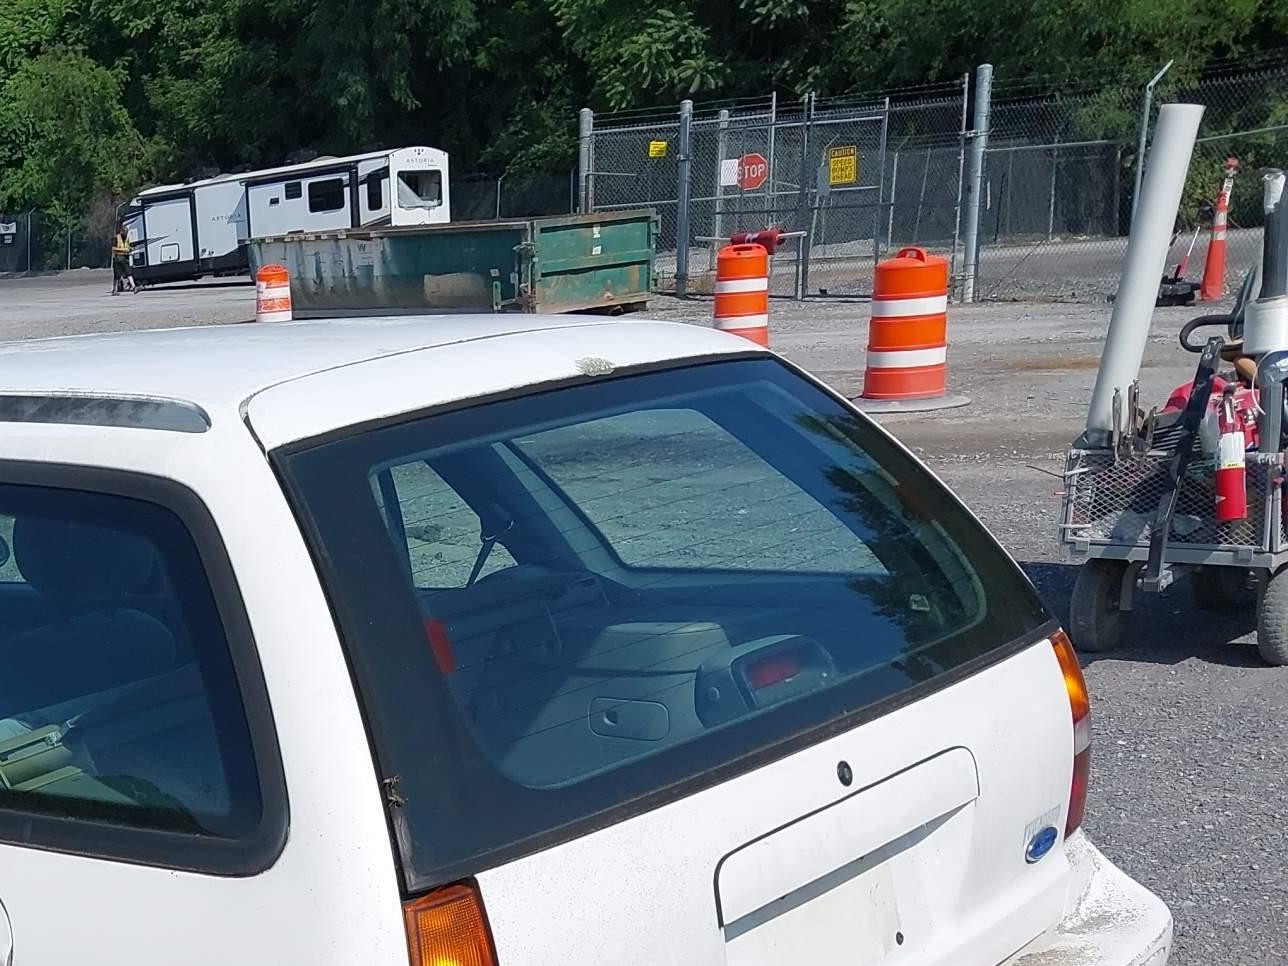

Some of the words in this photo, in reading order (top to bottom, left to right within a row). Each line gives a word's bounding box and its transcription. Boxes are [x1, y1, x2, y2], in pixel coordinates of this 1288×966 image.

[831, 148, 855, 157] CAUTION
[832, 158, 853, 167] SPEED
[736, 163, 765, 180] STOP
[832, 165, 853, 174] BUMPS
[832, 172, 853, 181] AHEAD
